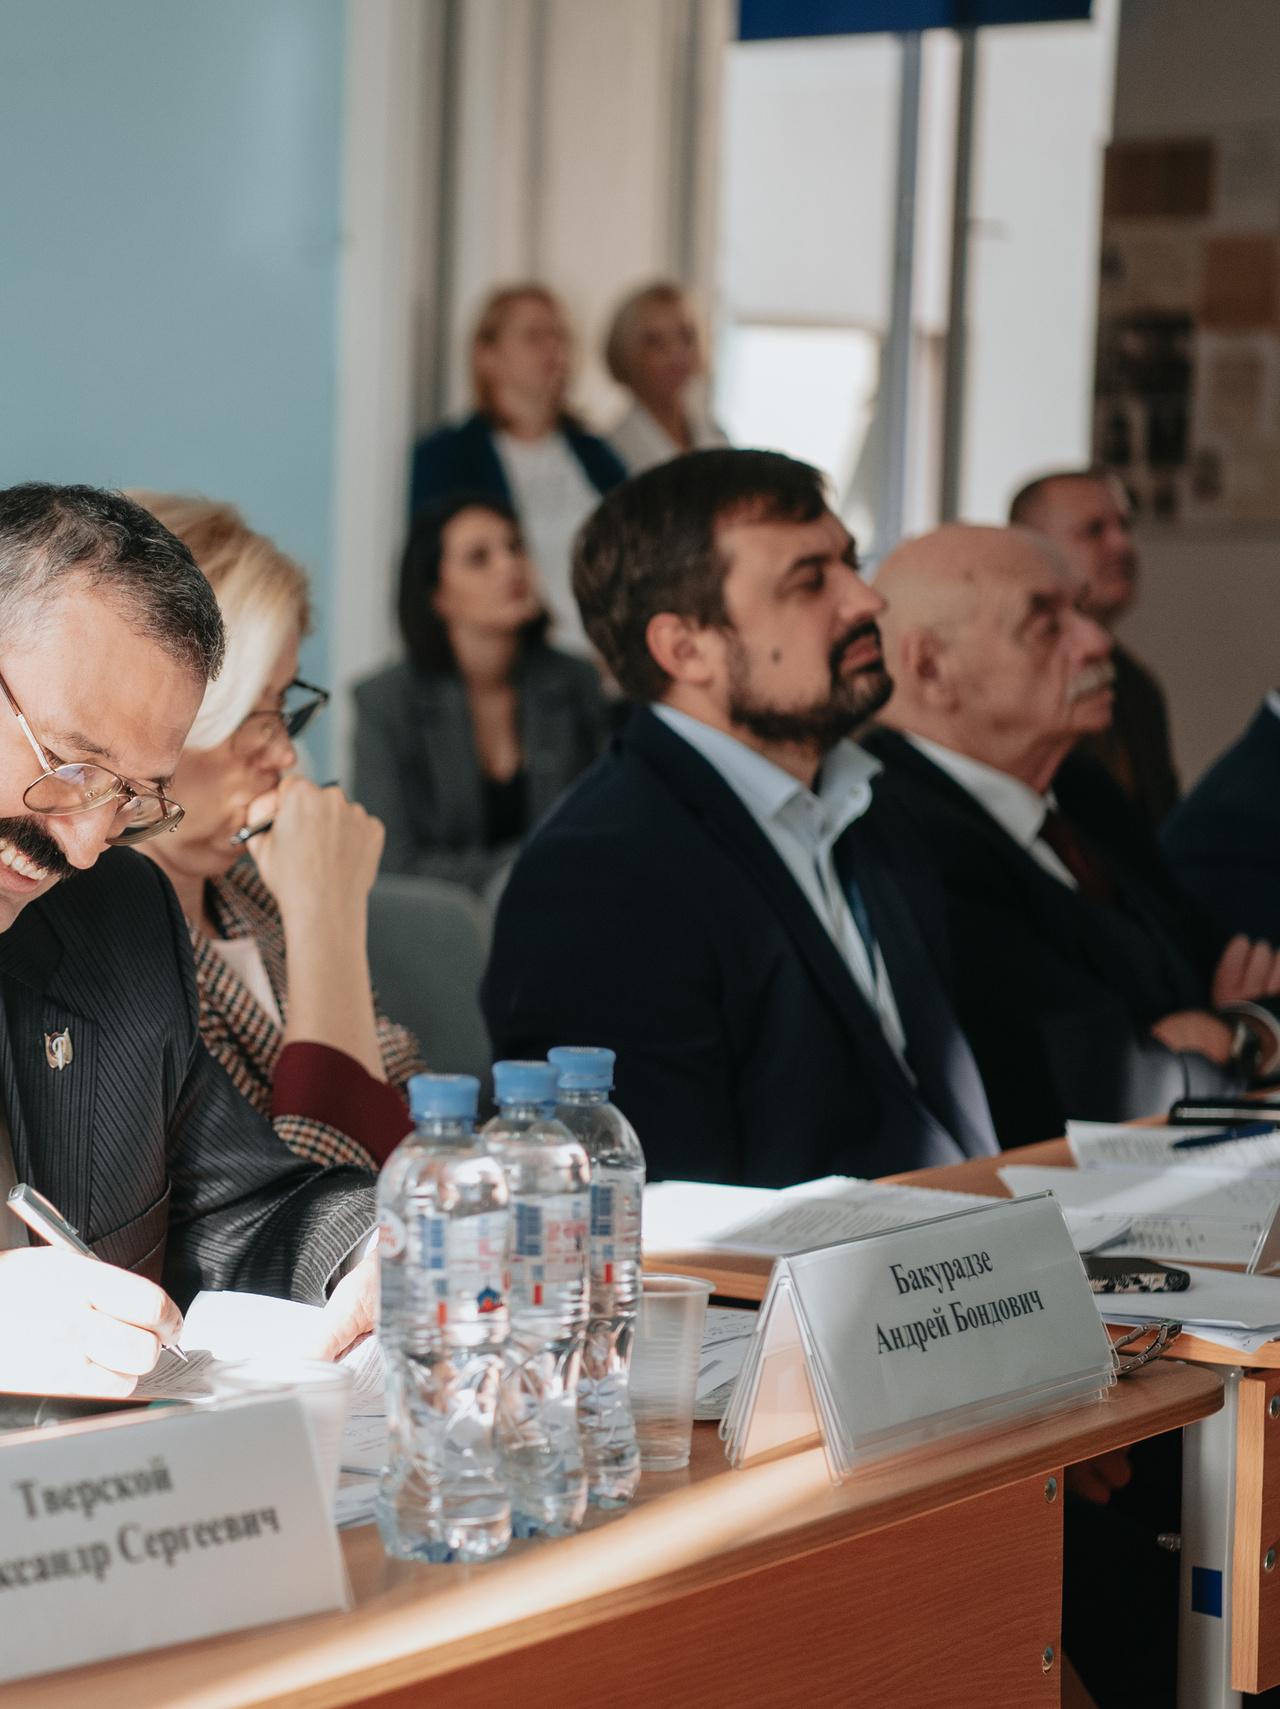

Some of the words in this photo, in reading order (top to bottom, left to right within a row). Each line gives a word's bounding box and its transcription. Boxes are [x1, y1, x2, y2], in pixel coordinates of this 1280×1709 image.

[888, 1251, 994, 1295] Бакурадзе
[875, 1306, 951, 1355] Андрей
[948, 1290, 1046, 1334] Бондович
[12, 1456, 174, 1520] Тверской
[116, 1506, 282, 1568] Сергеевич
